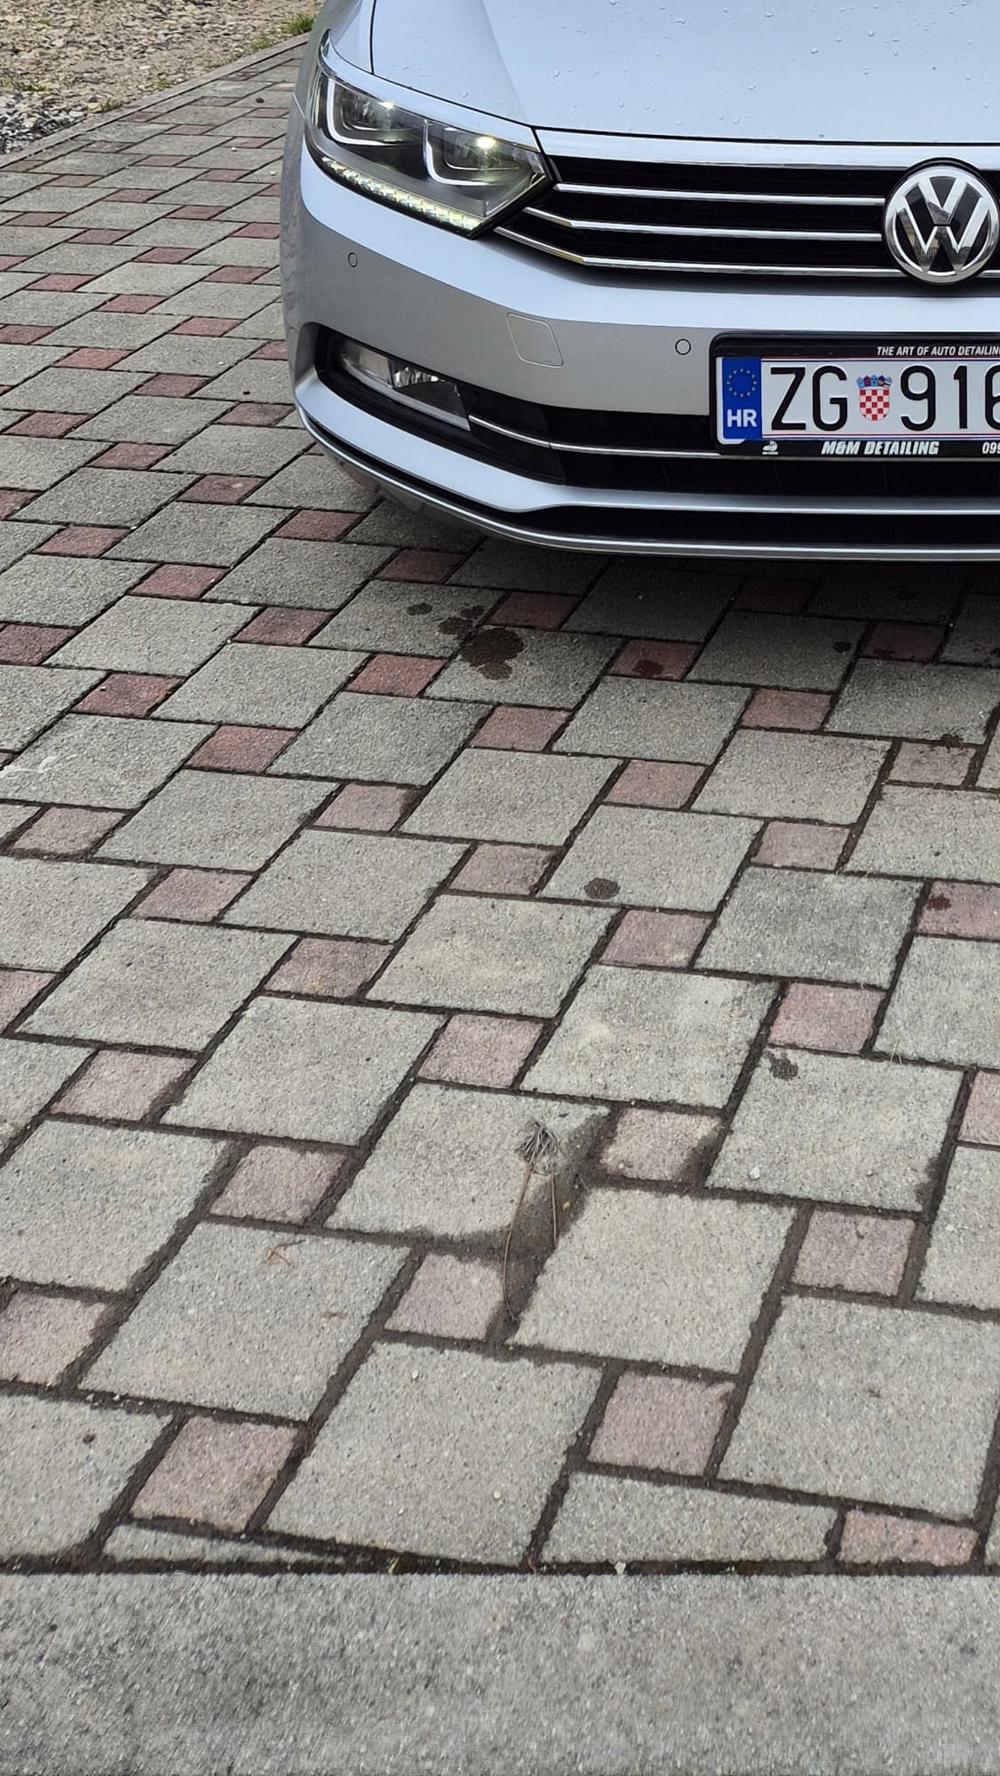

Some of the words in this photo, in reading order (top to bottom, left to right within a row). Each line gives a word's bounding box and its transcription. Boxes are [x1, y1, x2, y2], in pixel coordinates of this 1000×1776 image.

[876, 345, 895, 356] THE
[896, 345, 915, 356] ART
[916, 345, 930, 356] OF
[930, 345, 956, 356] AUTO
[770, 365, 848, 432] ZG
[726, 408, 758, 428] HR
[821, 440, 862, 455] M&M
[863, 440, 941, 455] DETAILING
